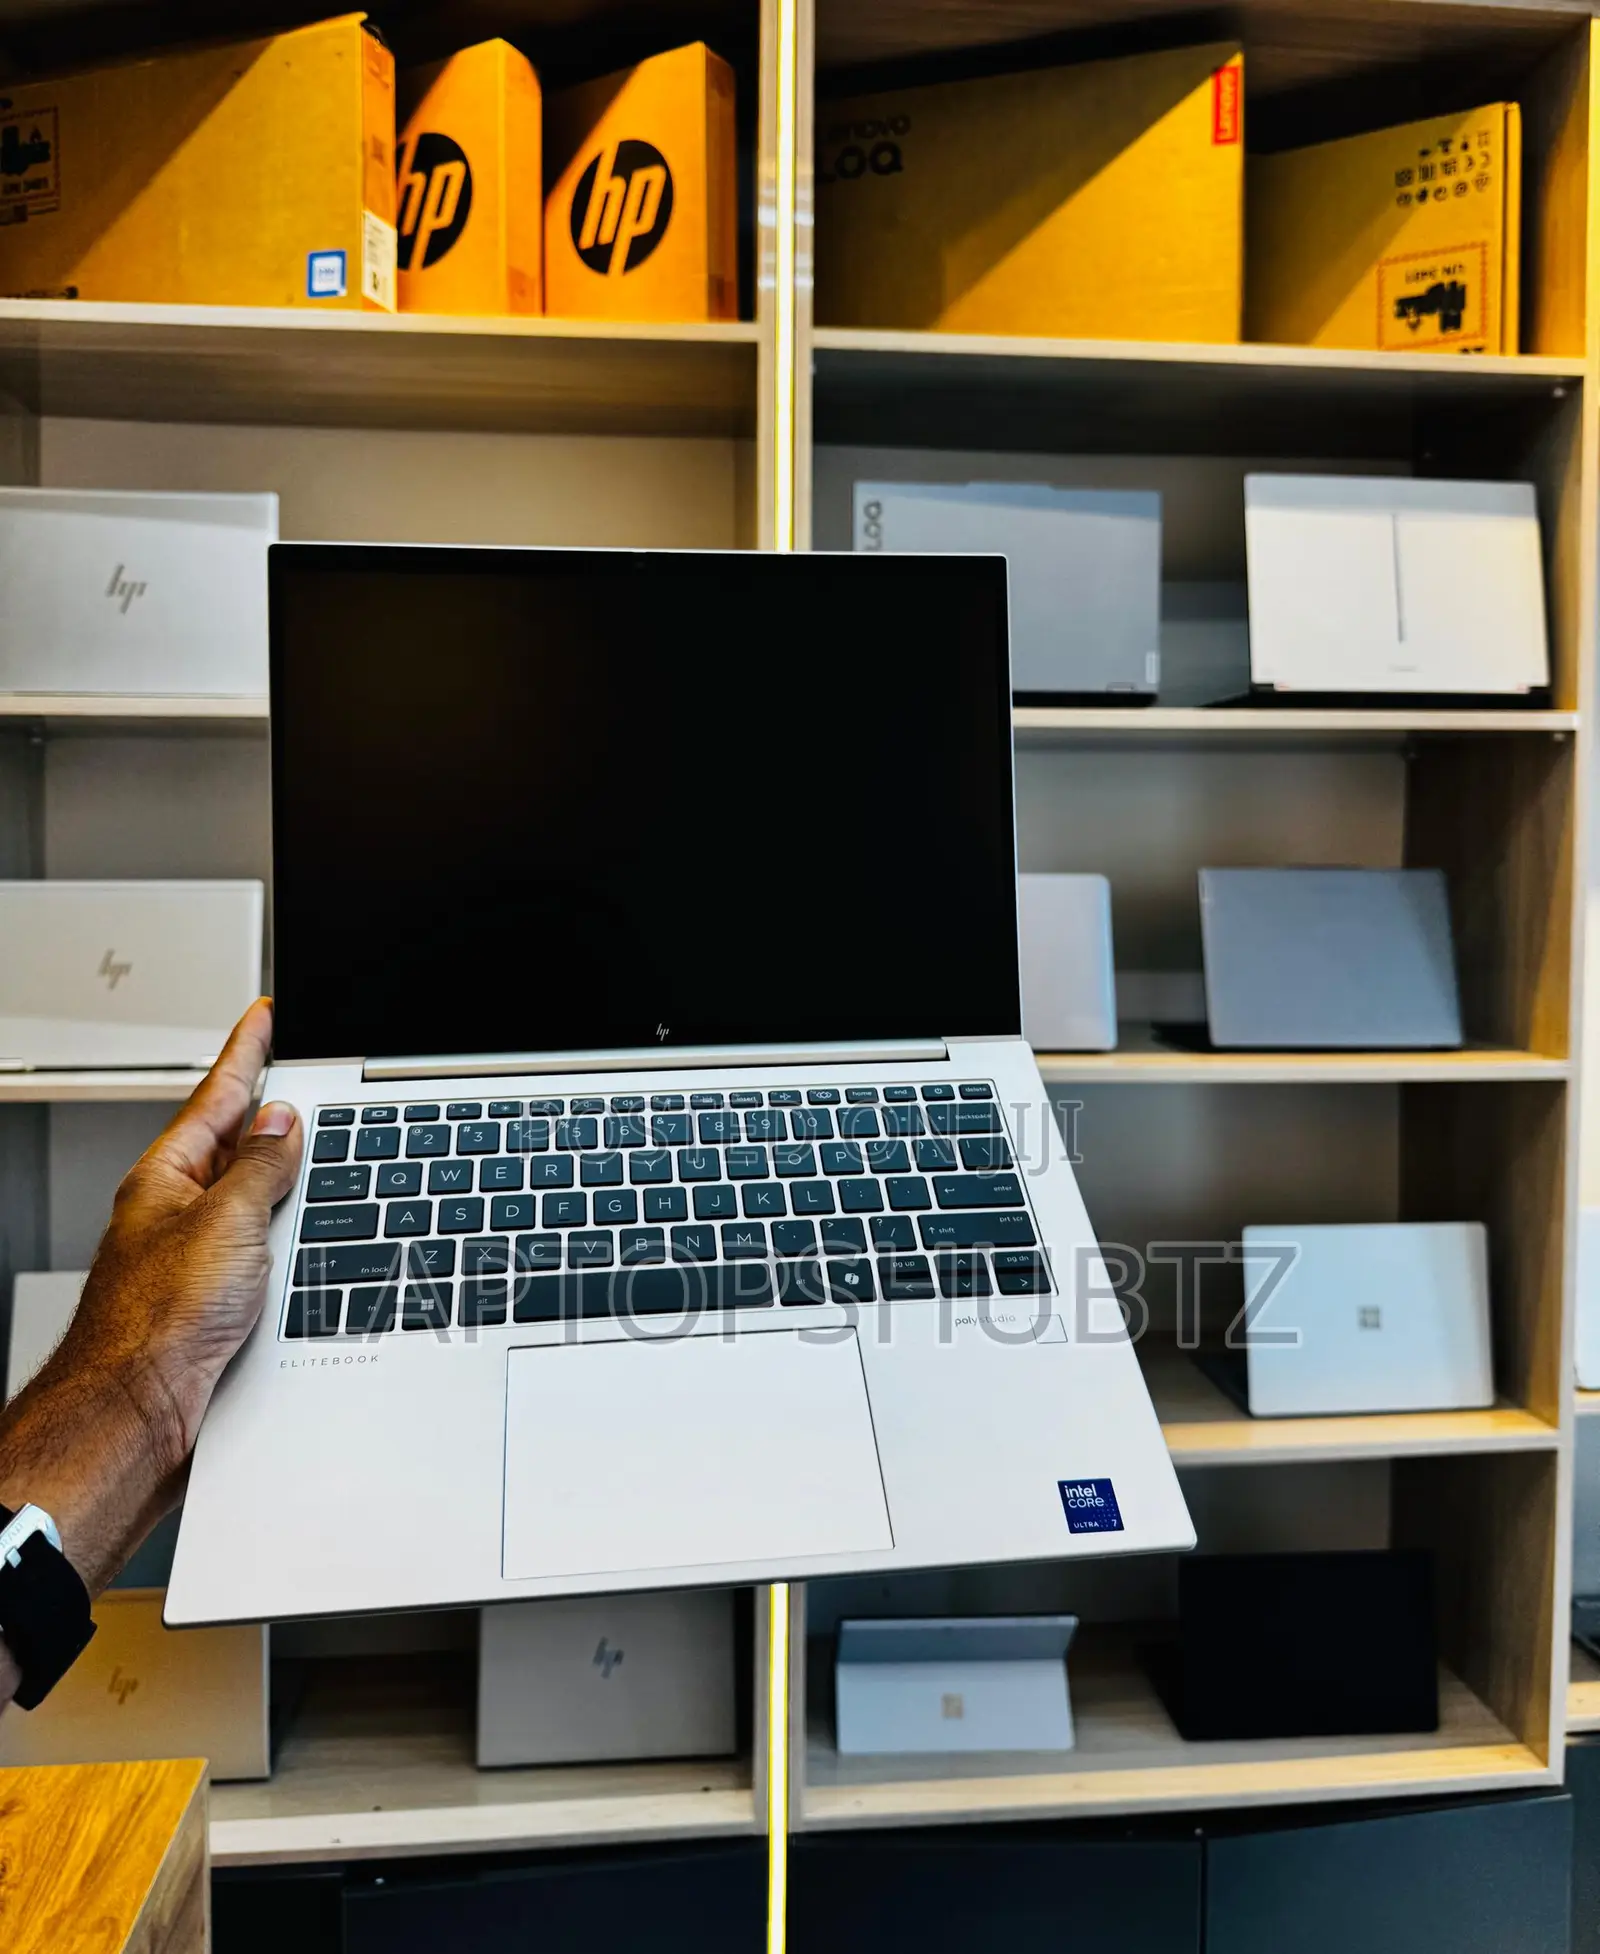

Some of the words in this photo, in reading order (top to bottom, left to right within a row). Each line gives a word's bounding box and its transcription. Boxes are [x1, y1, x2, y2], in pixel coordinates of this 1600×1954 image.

[577, 139, 667, 276] hp
[667, 1123, 676, 1134] 7
[714, 1121, 725, 1132] 8
[761, 1119, 771, 1130] 9
[411, 1127, 423, 1136] @
[424, 1134, 434, 1145] 2
[522, 1130, 533, 1140] 4
[572, 1127, 581, 1138] 5
[620, 1125, 630, 1136] 6
[375, 1136, 381, 1147] 1
[473, 1131, 483, 1142] 3
[391, 1172, 407, 1185] Q
[441, 1168, 461, 1182] W
[495, 1166, 507, 1179] E
[545, 1164, 557, 1176] R
[595, 1161, 607, 1174] T
[644, 1159, 657, 1172] Y
[692, 1157, 706, 1170] U
[787, 1153, 802, 1165] O
[835, 1151, 847, 1163] P
[399, 1211, 415, 1224] A
[455, 1207, 467, 1220] S
[505, 1204, 520, 1218] D
[558, 1202, 570, 1215] F
[608, 1199, 622, 1213] G
[658, 1197, 672, 1210] H
[711, 1194, 721, 1207] J
[757, 1192, 771, 1205] K
[806, 1190, 818, 1203] L
[424, 1250, 439, 1264] Z
[478, 1247, 492, 1261] X
[531, 1243, 545, 1257] C
[583, 1240, 598, 1254] V
[635, 1238, 648, 1251] B
[686, 1235, 700, 1249] N
[736, 1232, 752, 1246] M
[371, 1265, 389, 1273] lock
[280, 1355, 379, 1368] ELITEBOOK
[1064, 1483, 1098, 1499] intel
[1111, 1519, 1117, 1527] 7
